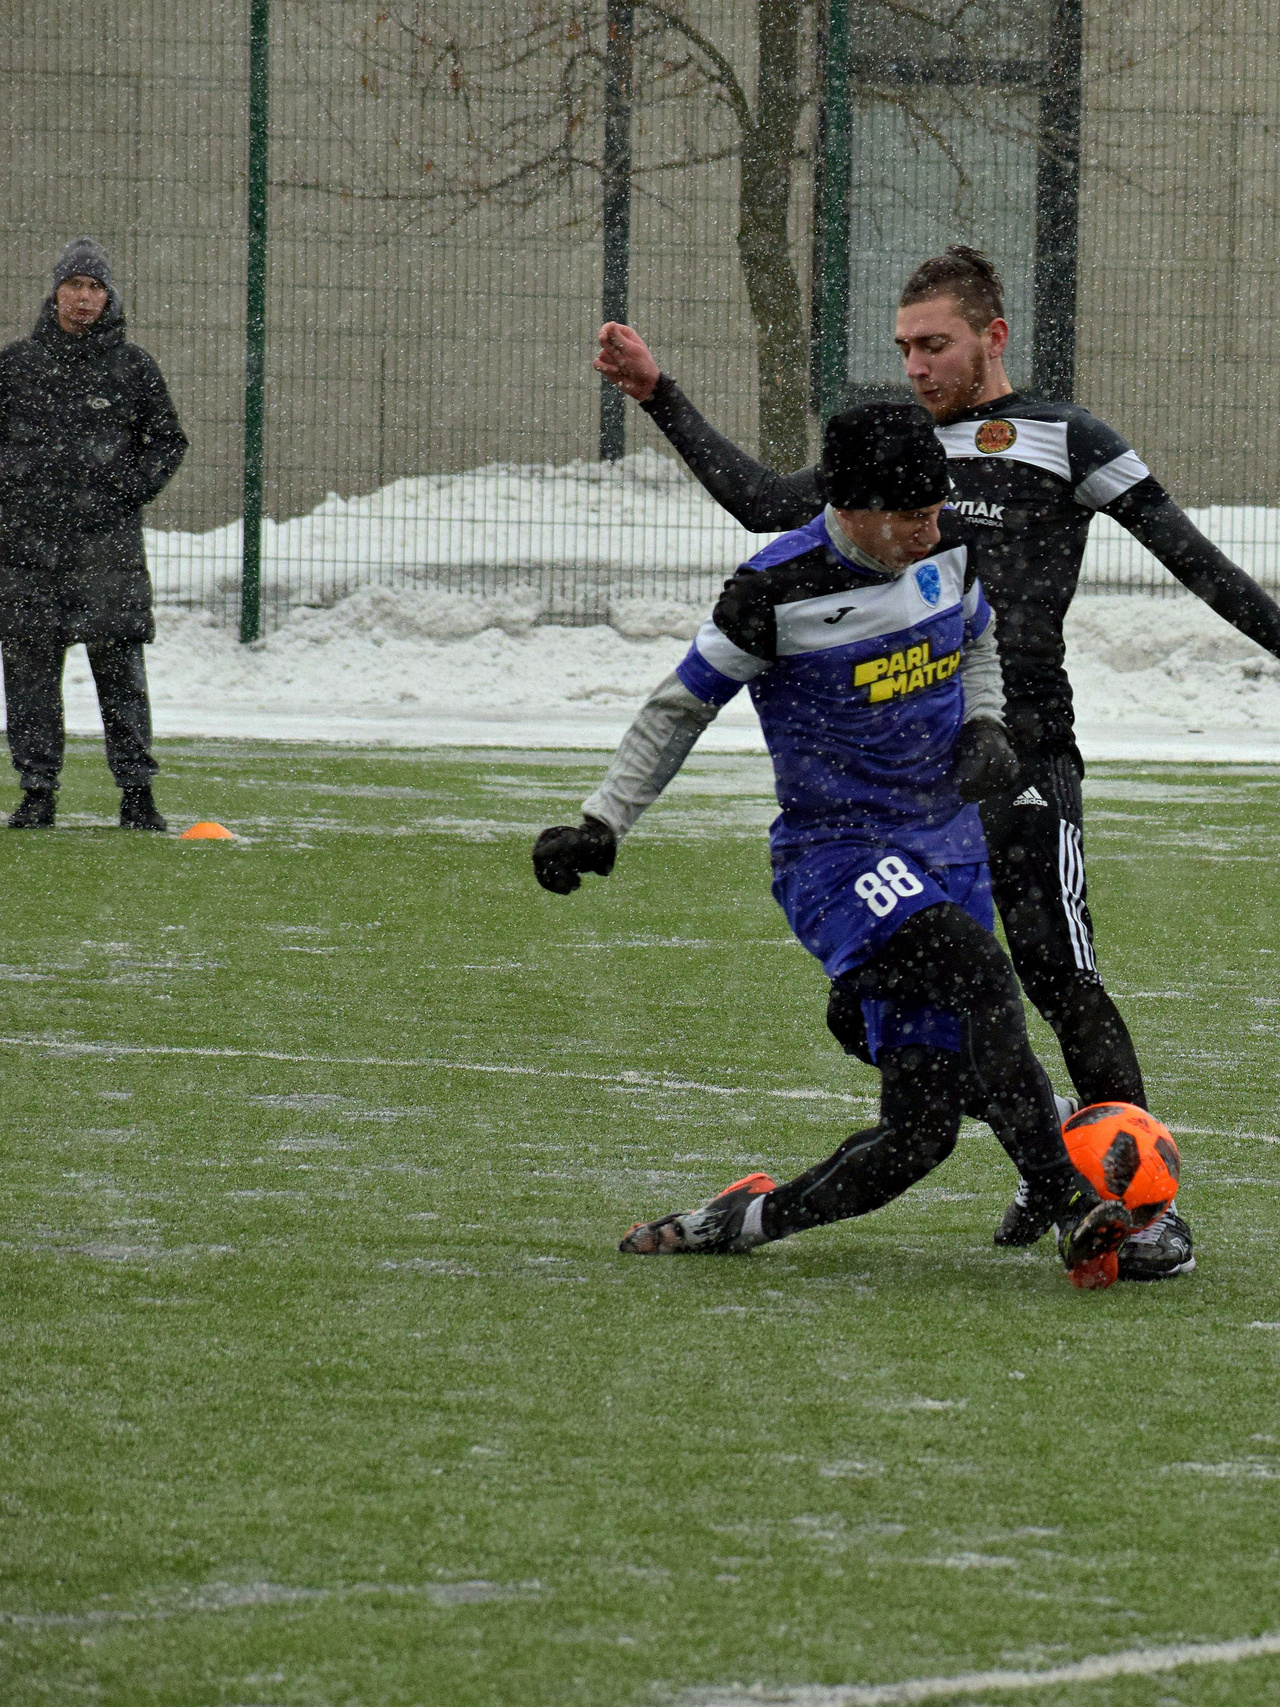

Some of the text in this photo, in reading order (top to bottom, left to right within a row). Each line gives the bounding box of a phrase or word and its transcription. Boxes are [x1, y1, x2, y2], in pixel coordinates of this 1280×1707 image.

[854, 643, 929, 687] PARI
[869, 651, 961, 703] MATCH
[1012, 797, 1049, 807] adidas
[854, 855, 924, 917] 88
